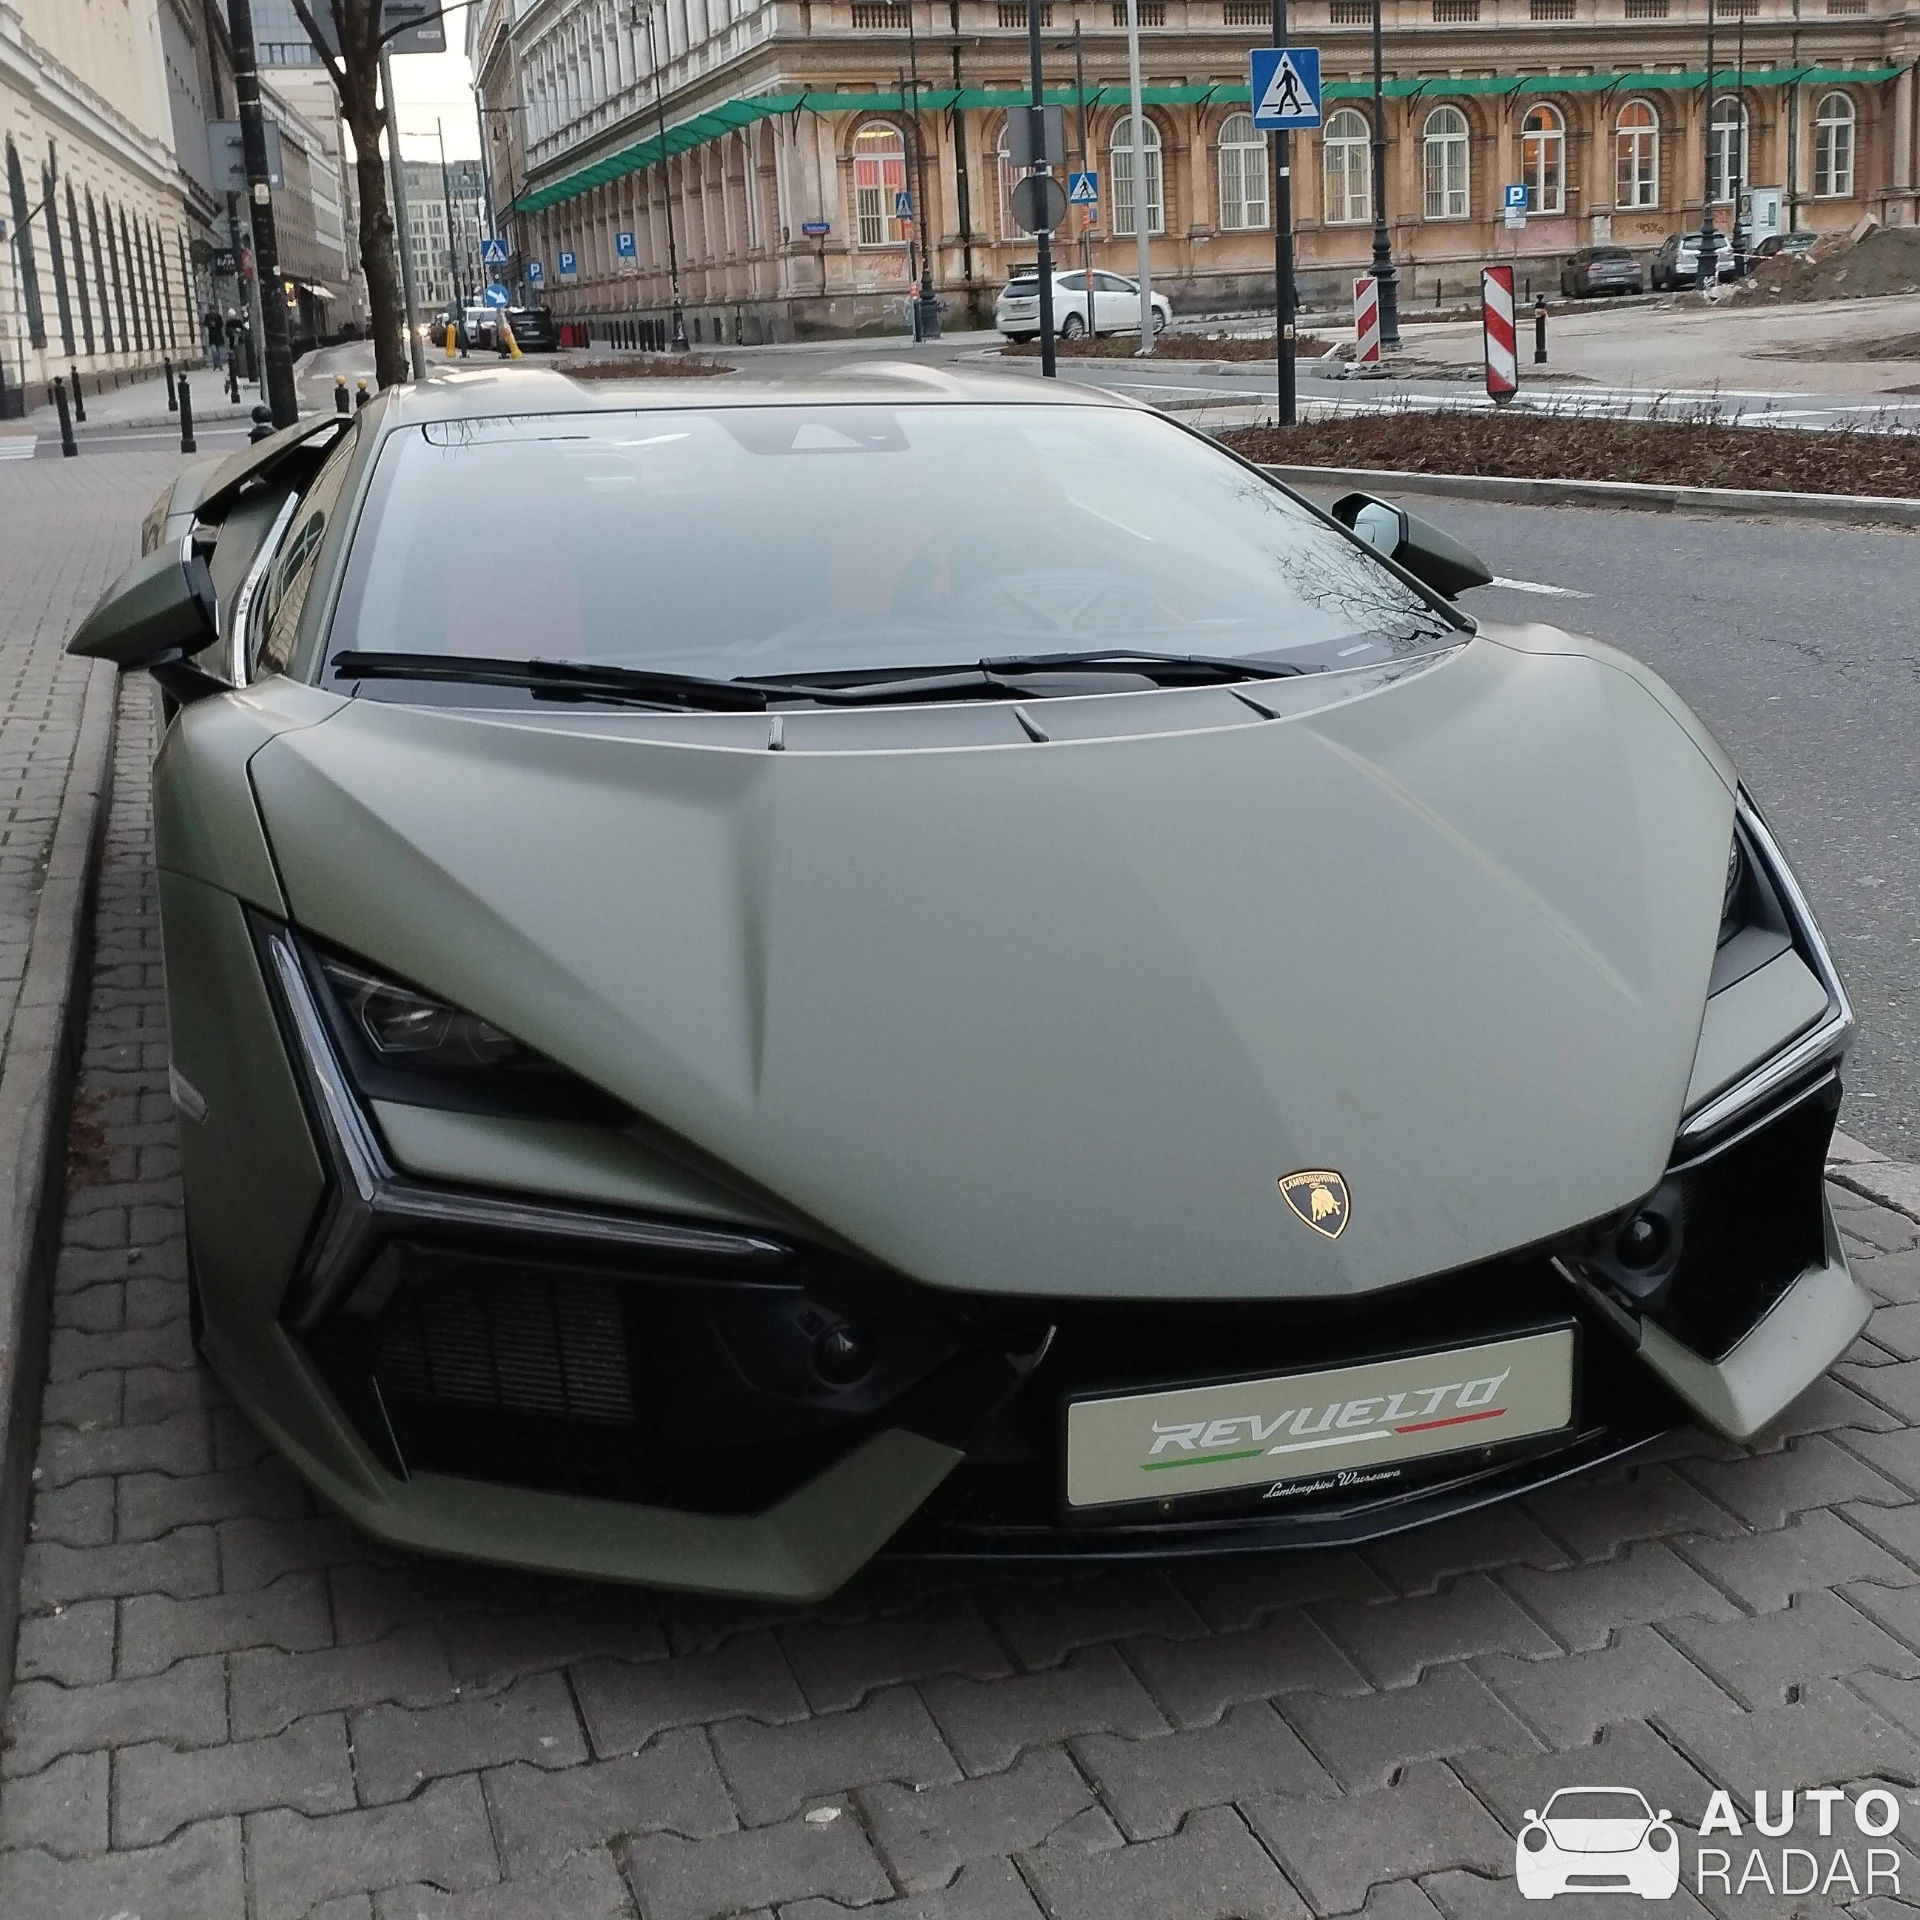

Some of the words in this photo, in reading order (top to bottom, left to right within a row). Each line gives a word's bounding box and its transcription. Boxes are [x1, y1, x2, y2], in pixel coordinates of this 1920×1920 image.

[1510, 187, 1523, 205] P
[620, 234, 631, 250] P
[562, 254, 573, 268] P
[530, 264, 540, 277] P
[1283, 1174, 1340, 1191] LAMBORGHINI
[1149, 1367, 1511, 1454] REVUELTO
[1263, 1479, 1336, 1499] Lamborghini
